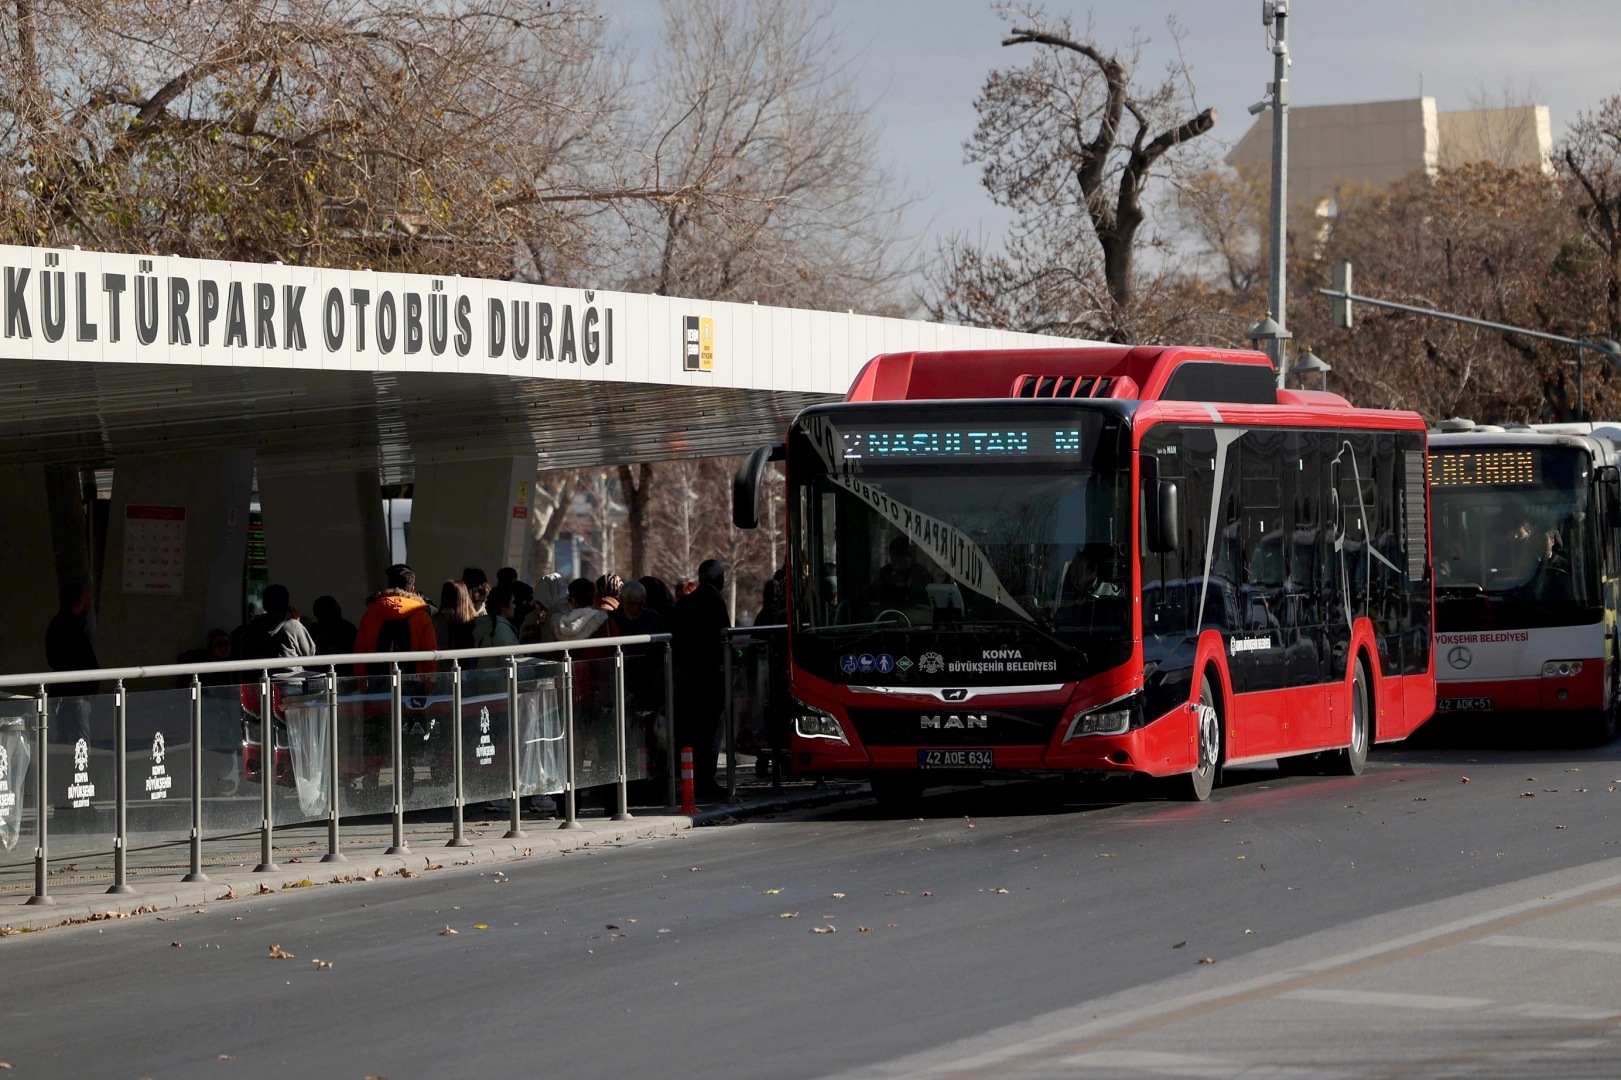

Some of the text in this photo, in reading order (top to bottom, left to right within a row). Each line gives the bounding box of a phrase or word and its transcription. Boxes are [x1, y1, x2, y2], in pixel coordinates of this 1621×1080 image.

[4, 253, 614, 365] KÜLTÜRPARK OTOBÜS DURAĞI
[1480, 631, 1529, 643] BELEDİYESİ
[982, 650, 1022, 659] KONYA
[949, 658, 1057, 674] BÜYÜKŞEHİR BELEDİYESİ
[1439, 700, 1451, 709] 42
[921, 715, 987, 728] MAN
[926, 751, 941, 764] 42
[968, 751, 991, 765] 634
